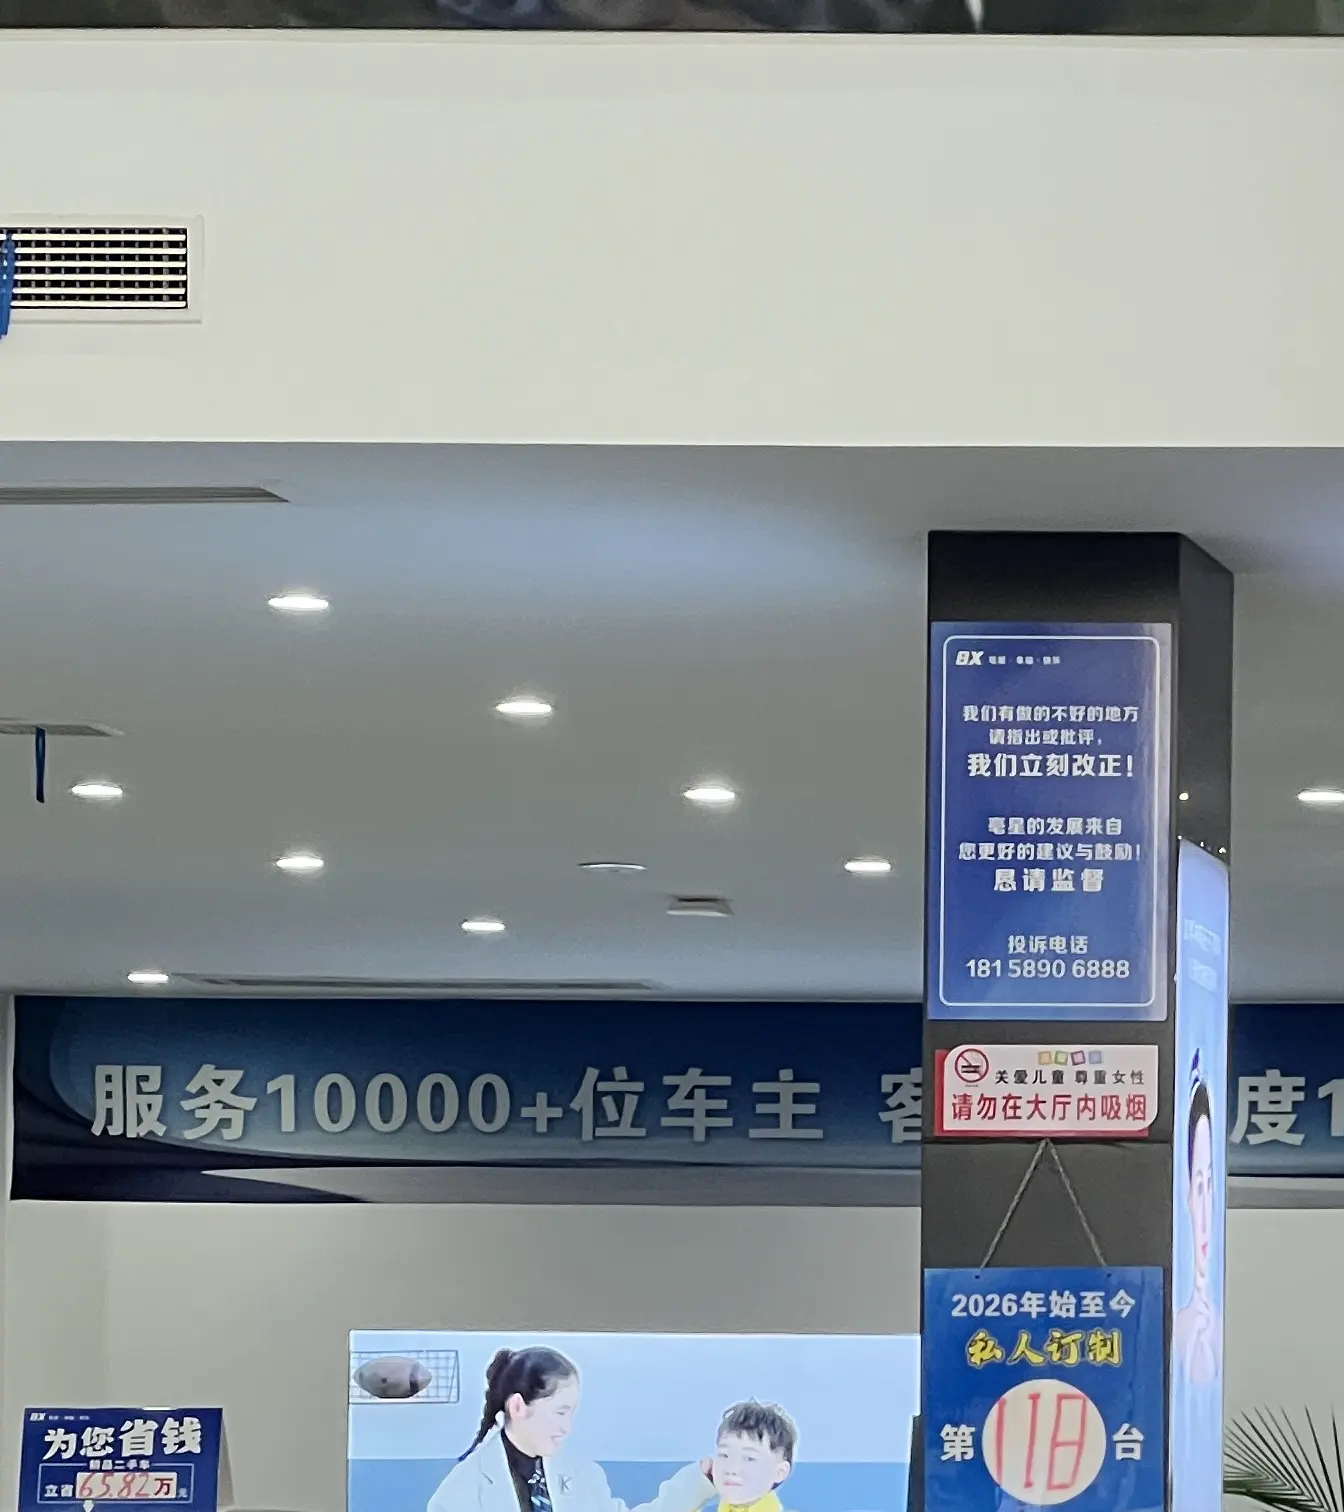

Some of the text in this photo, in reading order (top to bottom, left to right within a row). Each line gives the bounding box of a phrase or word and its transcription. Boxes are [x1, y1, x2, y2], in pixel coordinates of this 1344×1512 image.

[962, 705, 1139, 722] 我们有做的不好的地方
[967, 753, 1134, 778] 我们立刻改正！
[994, 867, 1104, 892] 恳请监督
[1007, 934, 1088, 954] 投诉电话
[966, 959, 1130, 979] 181 5890 6888
[995, 1069, 1145, 1085] 关爱儿童 尊重女性
[91, 1063, 824, 1142] 服务10000+位车主
[952, 1093, 1147, 1121] 请勿在大厅内吸烟
[951, 1289, 1136, 1318] 2026年始至今
[967, 1329, 1122, 1366] 私人订制
[43, 1416, 202, 1460] 为您省钱
[939, 1423, 977, 1462] 第
[1112, 1423, 1145, 1461] 台
